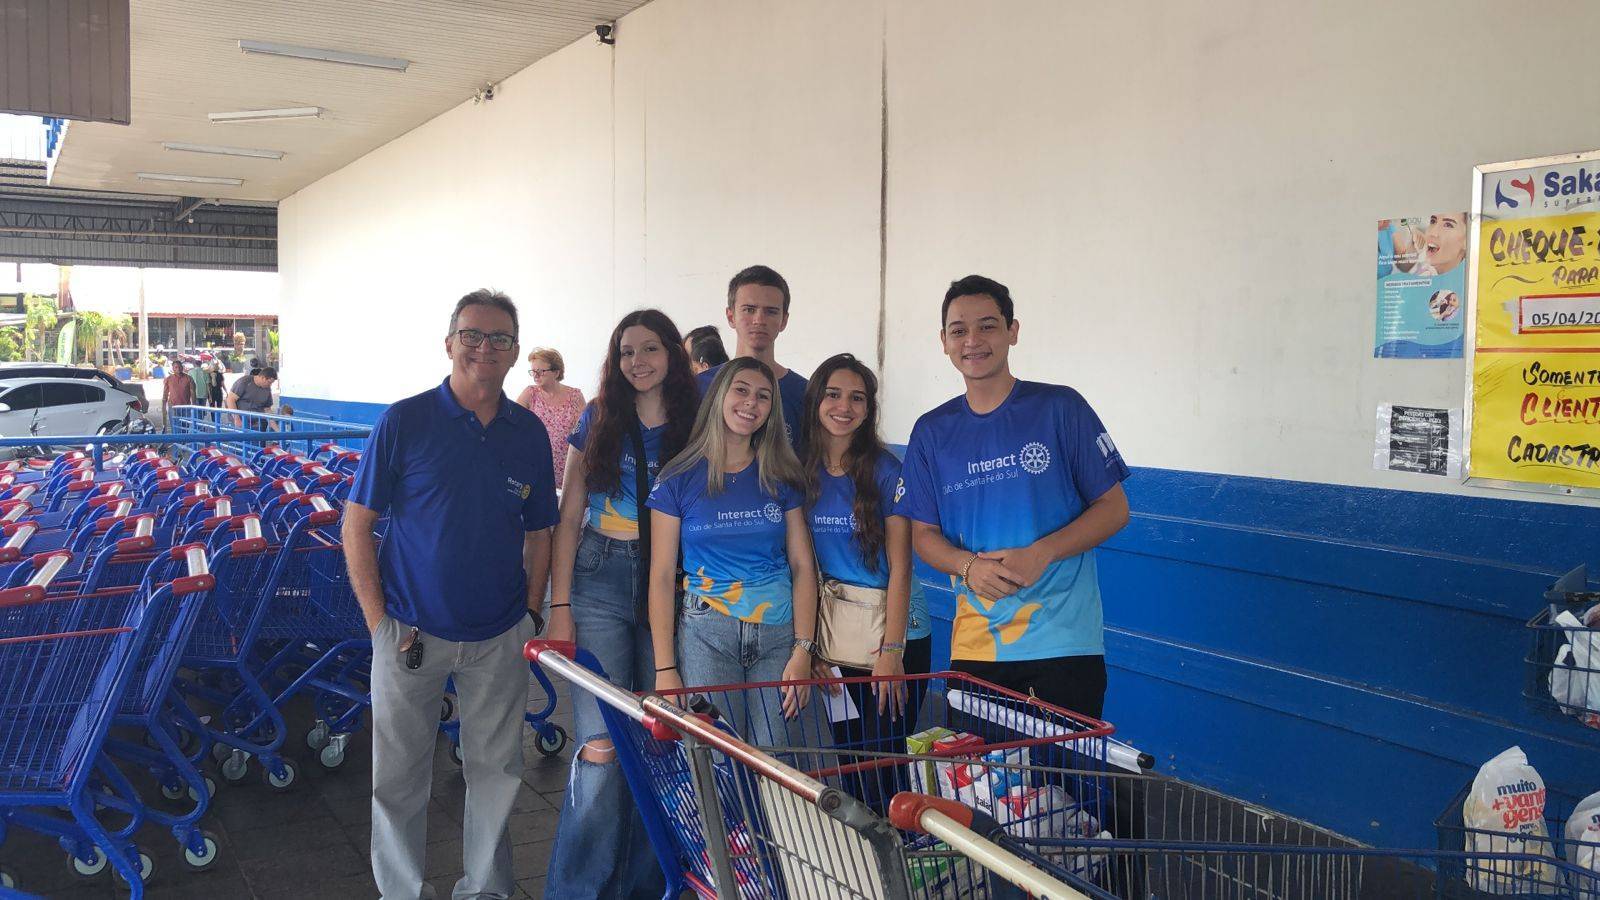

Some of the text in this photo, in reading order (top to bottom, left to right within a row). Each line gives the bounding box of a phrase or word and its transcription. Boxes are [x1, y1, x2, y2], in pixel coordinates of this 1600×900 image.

[1523, 361, 1600, 385] SOMENT
[967, 453, 1016, 474] Interact
[965, 476, 985, 488] Santa
[996, 472, 1004, 480] do
[1006, 468, 1018, 479] Sul
[717, 509, 762, 520] Interact
[814, 514, 848, 526] Interact
[714, 521, 732, 529] Santa
[1497, 779, 1536, 795] muito
